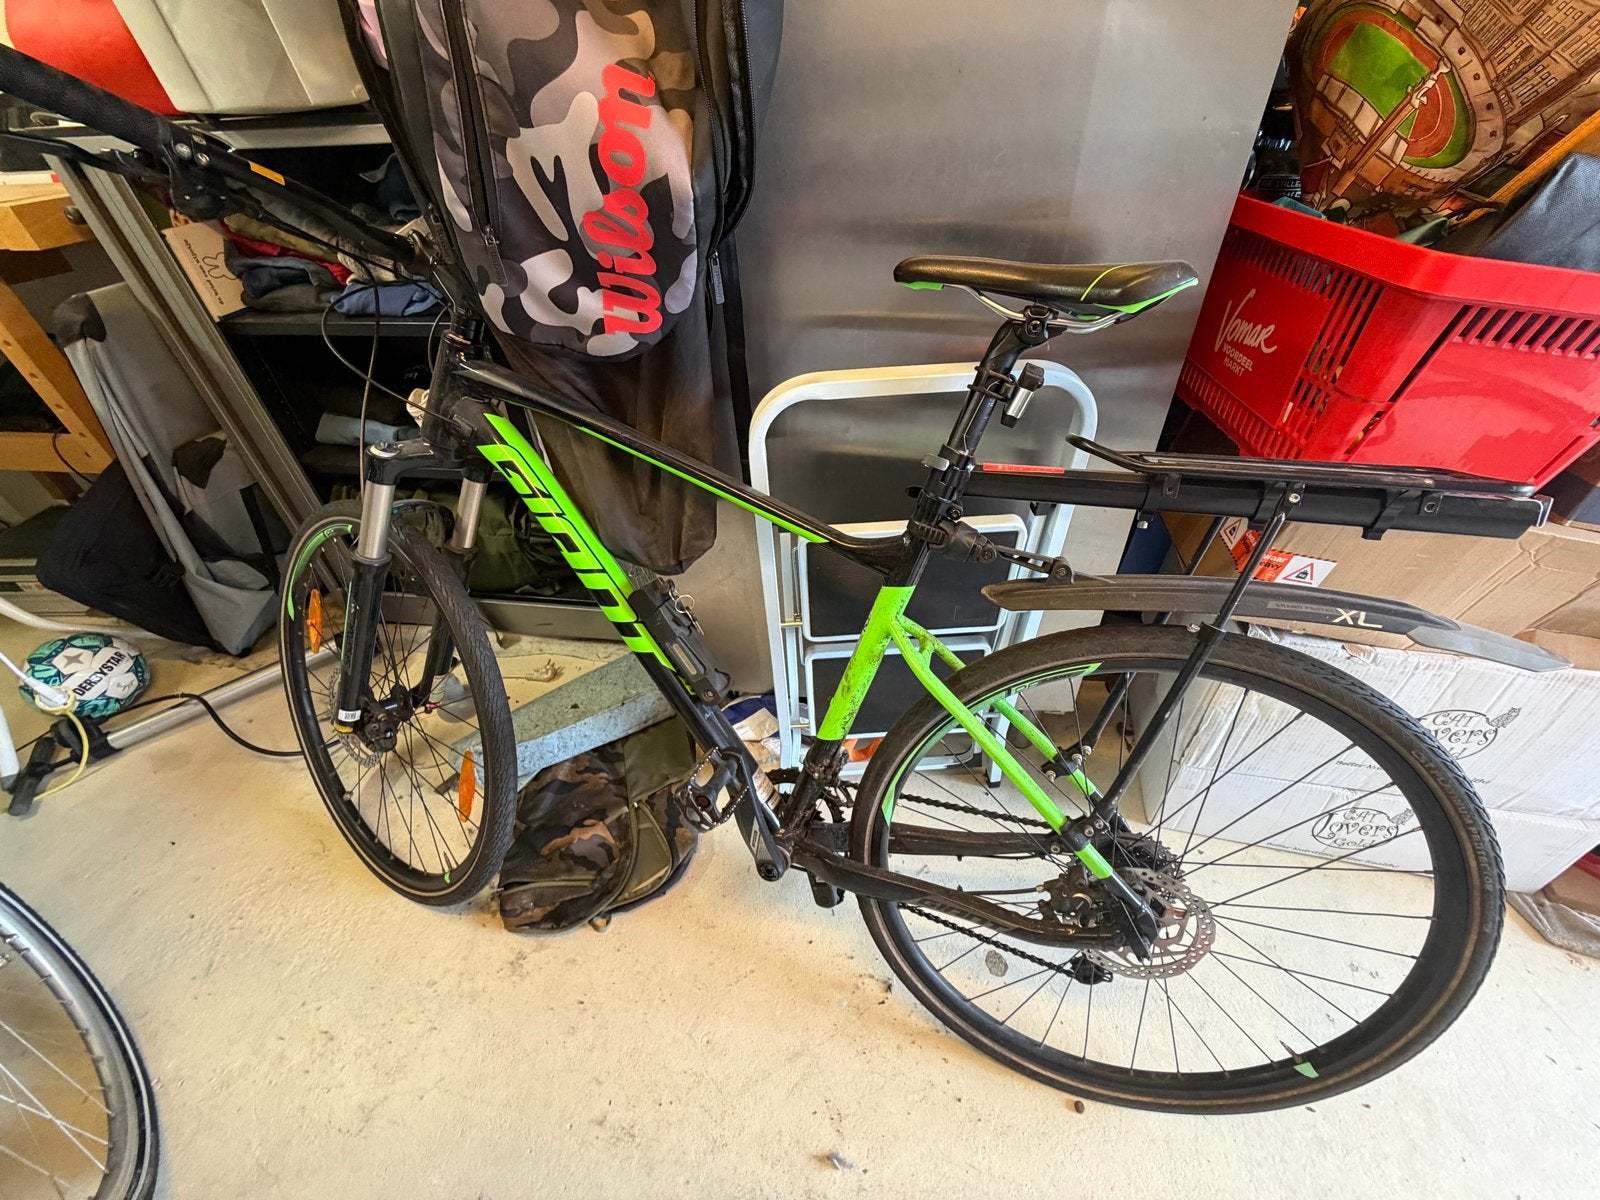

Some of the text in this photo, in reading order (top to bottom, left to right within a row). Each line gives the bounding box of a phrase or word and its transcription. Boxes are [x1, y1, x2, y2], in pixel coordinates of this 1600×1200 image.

[582, 64, 663, 335] Wilson
[1223, 342, 1254, 371] VOORDEEL
[1223, 356, 1245, 376] MARKT
[476, 444, 677, 672] GIANT
[1259, 561, 1283, 571] eavy
[1264, 554, 1289, 563] waar
[1332, 607, 1383, 629] XL
[1432, 711, 1480, 728] CAT
[1433, 727, 1496, 746] vers
[1314, 811, 1399, 840] Lovers
[1343, 808, 1377, 824] CAT
